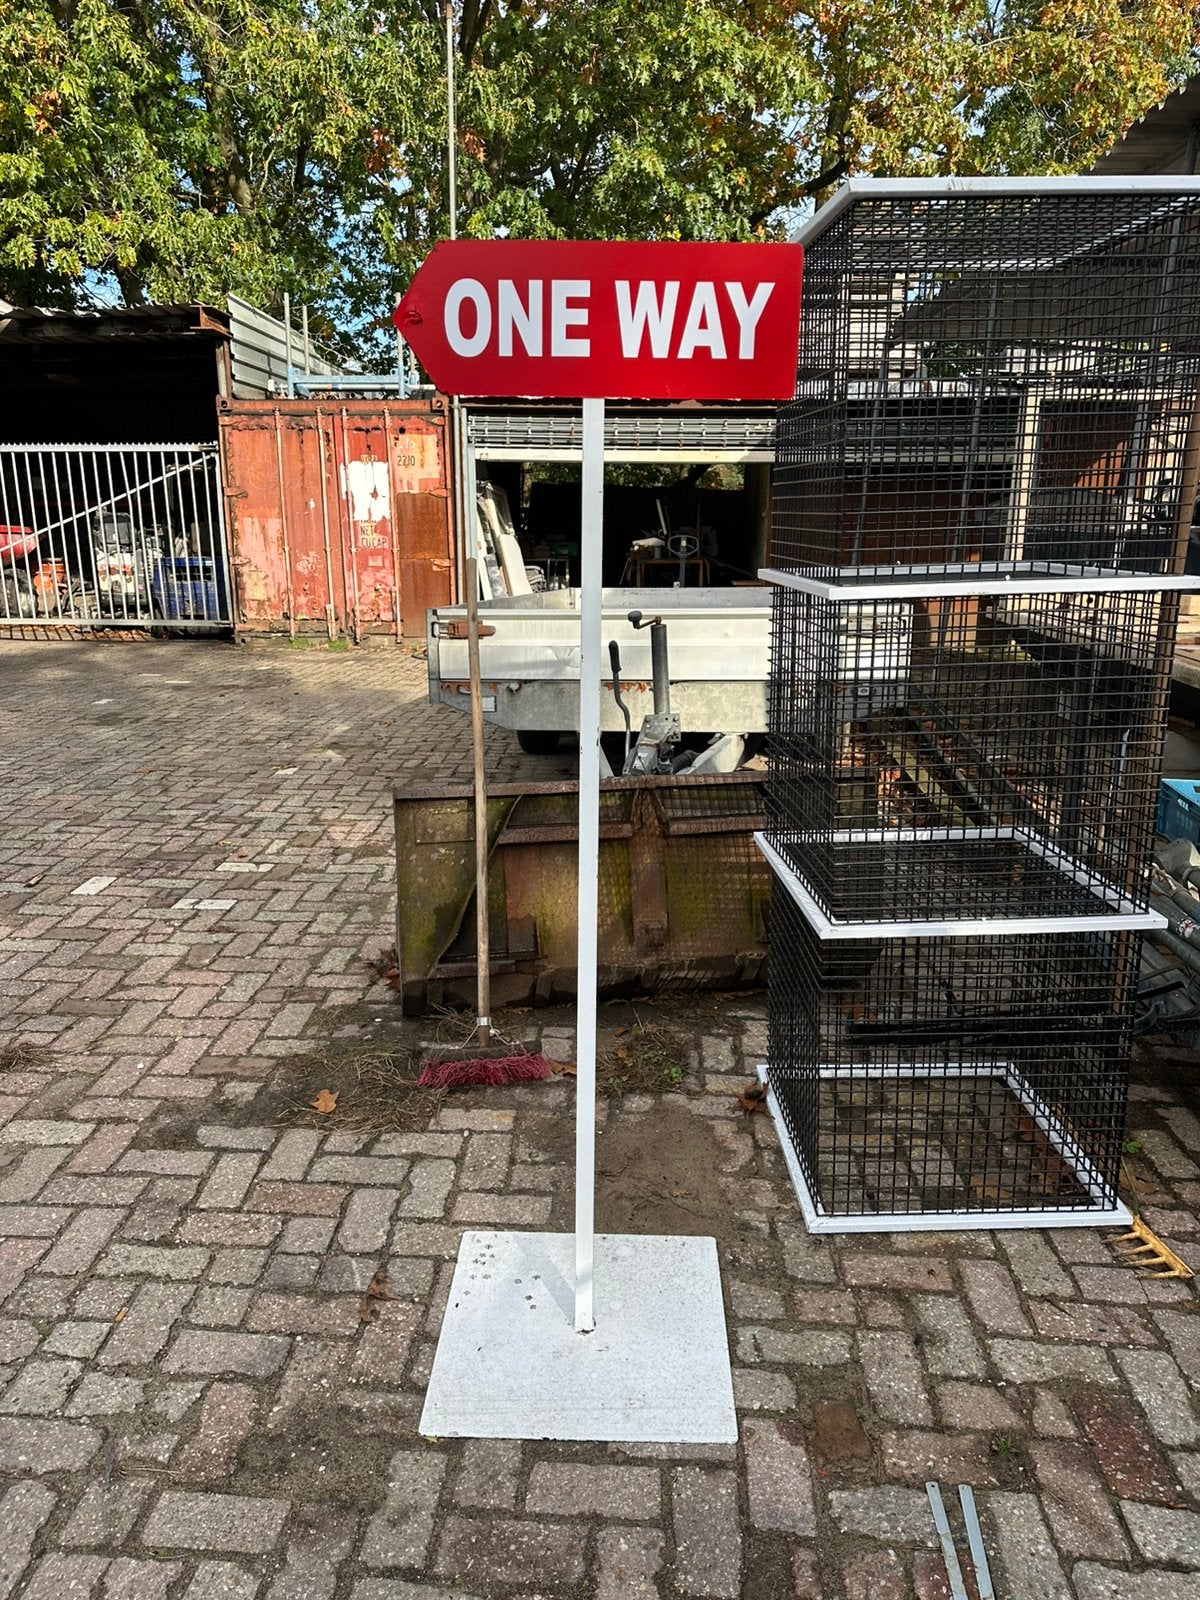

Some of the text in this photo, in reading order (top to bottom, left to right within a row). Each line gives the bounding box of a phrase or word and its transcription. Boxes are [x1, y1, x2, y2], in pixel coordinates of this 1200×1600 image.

[444, 278, 776, 360] ONE WAY
[360, 525, 374, 536] NET
